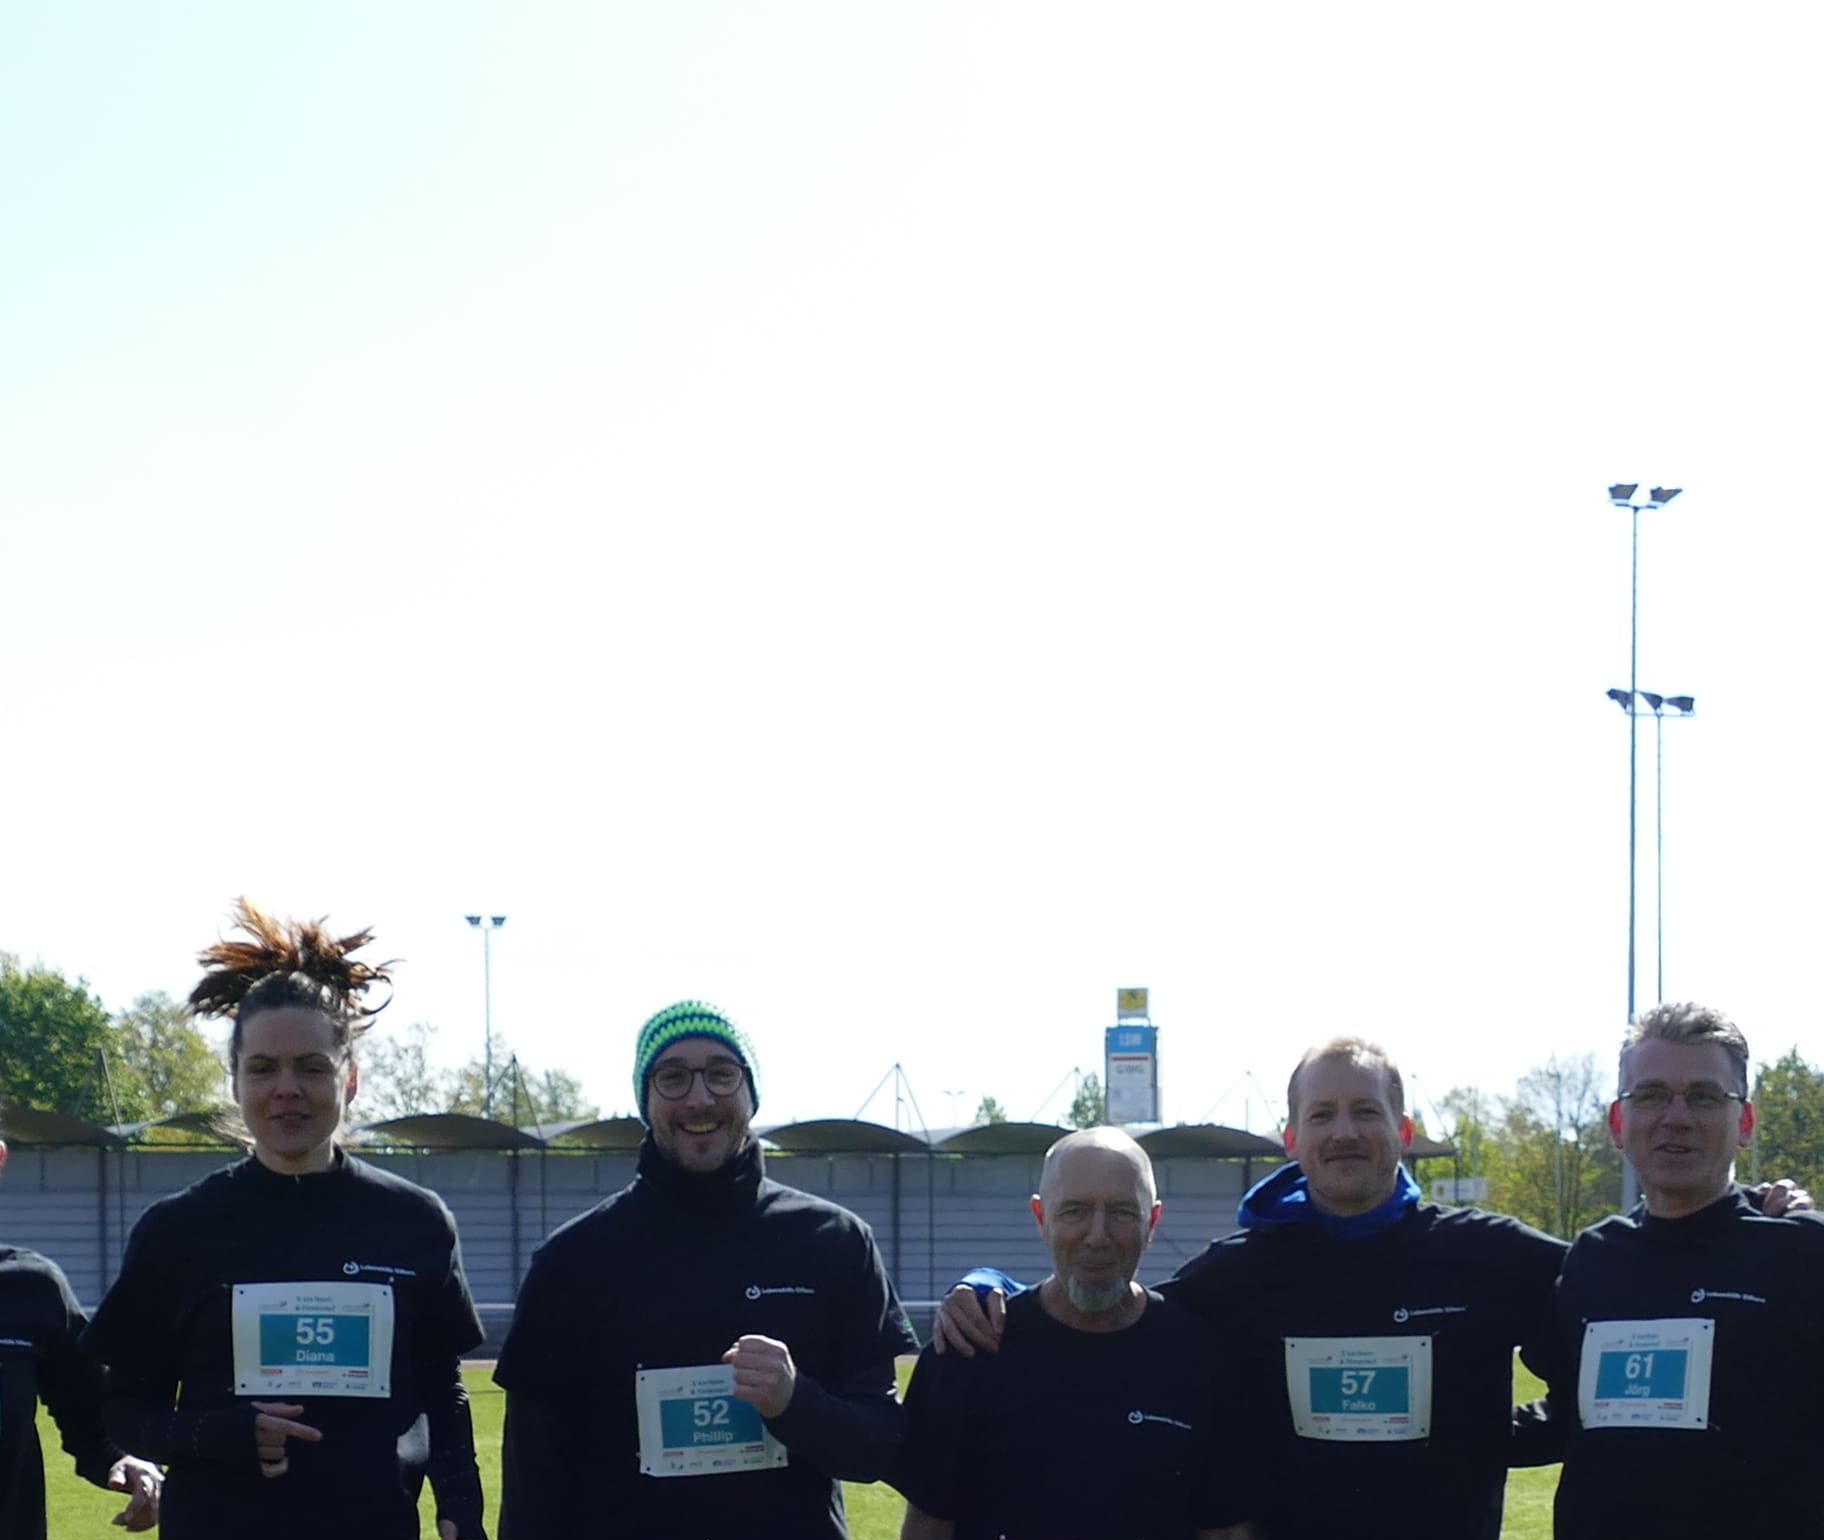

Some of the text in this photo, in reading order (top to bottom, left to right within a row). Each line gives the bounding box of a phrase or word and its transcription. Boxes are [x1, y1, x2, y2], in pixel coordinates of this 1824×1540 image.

[295, 1317, 336, 1345] 55
[295, 1350, 336, 1363] Diana
[1625, 1353, 1655, 1379] 61
[1341, 1369, 1377, 1395] 57
[693, 1399, 731, 1427] 52
[1342, 1399, 1376, 1411] Falko
[693, 1430, 735, 1444] Phillip
